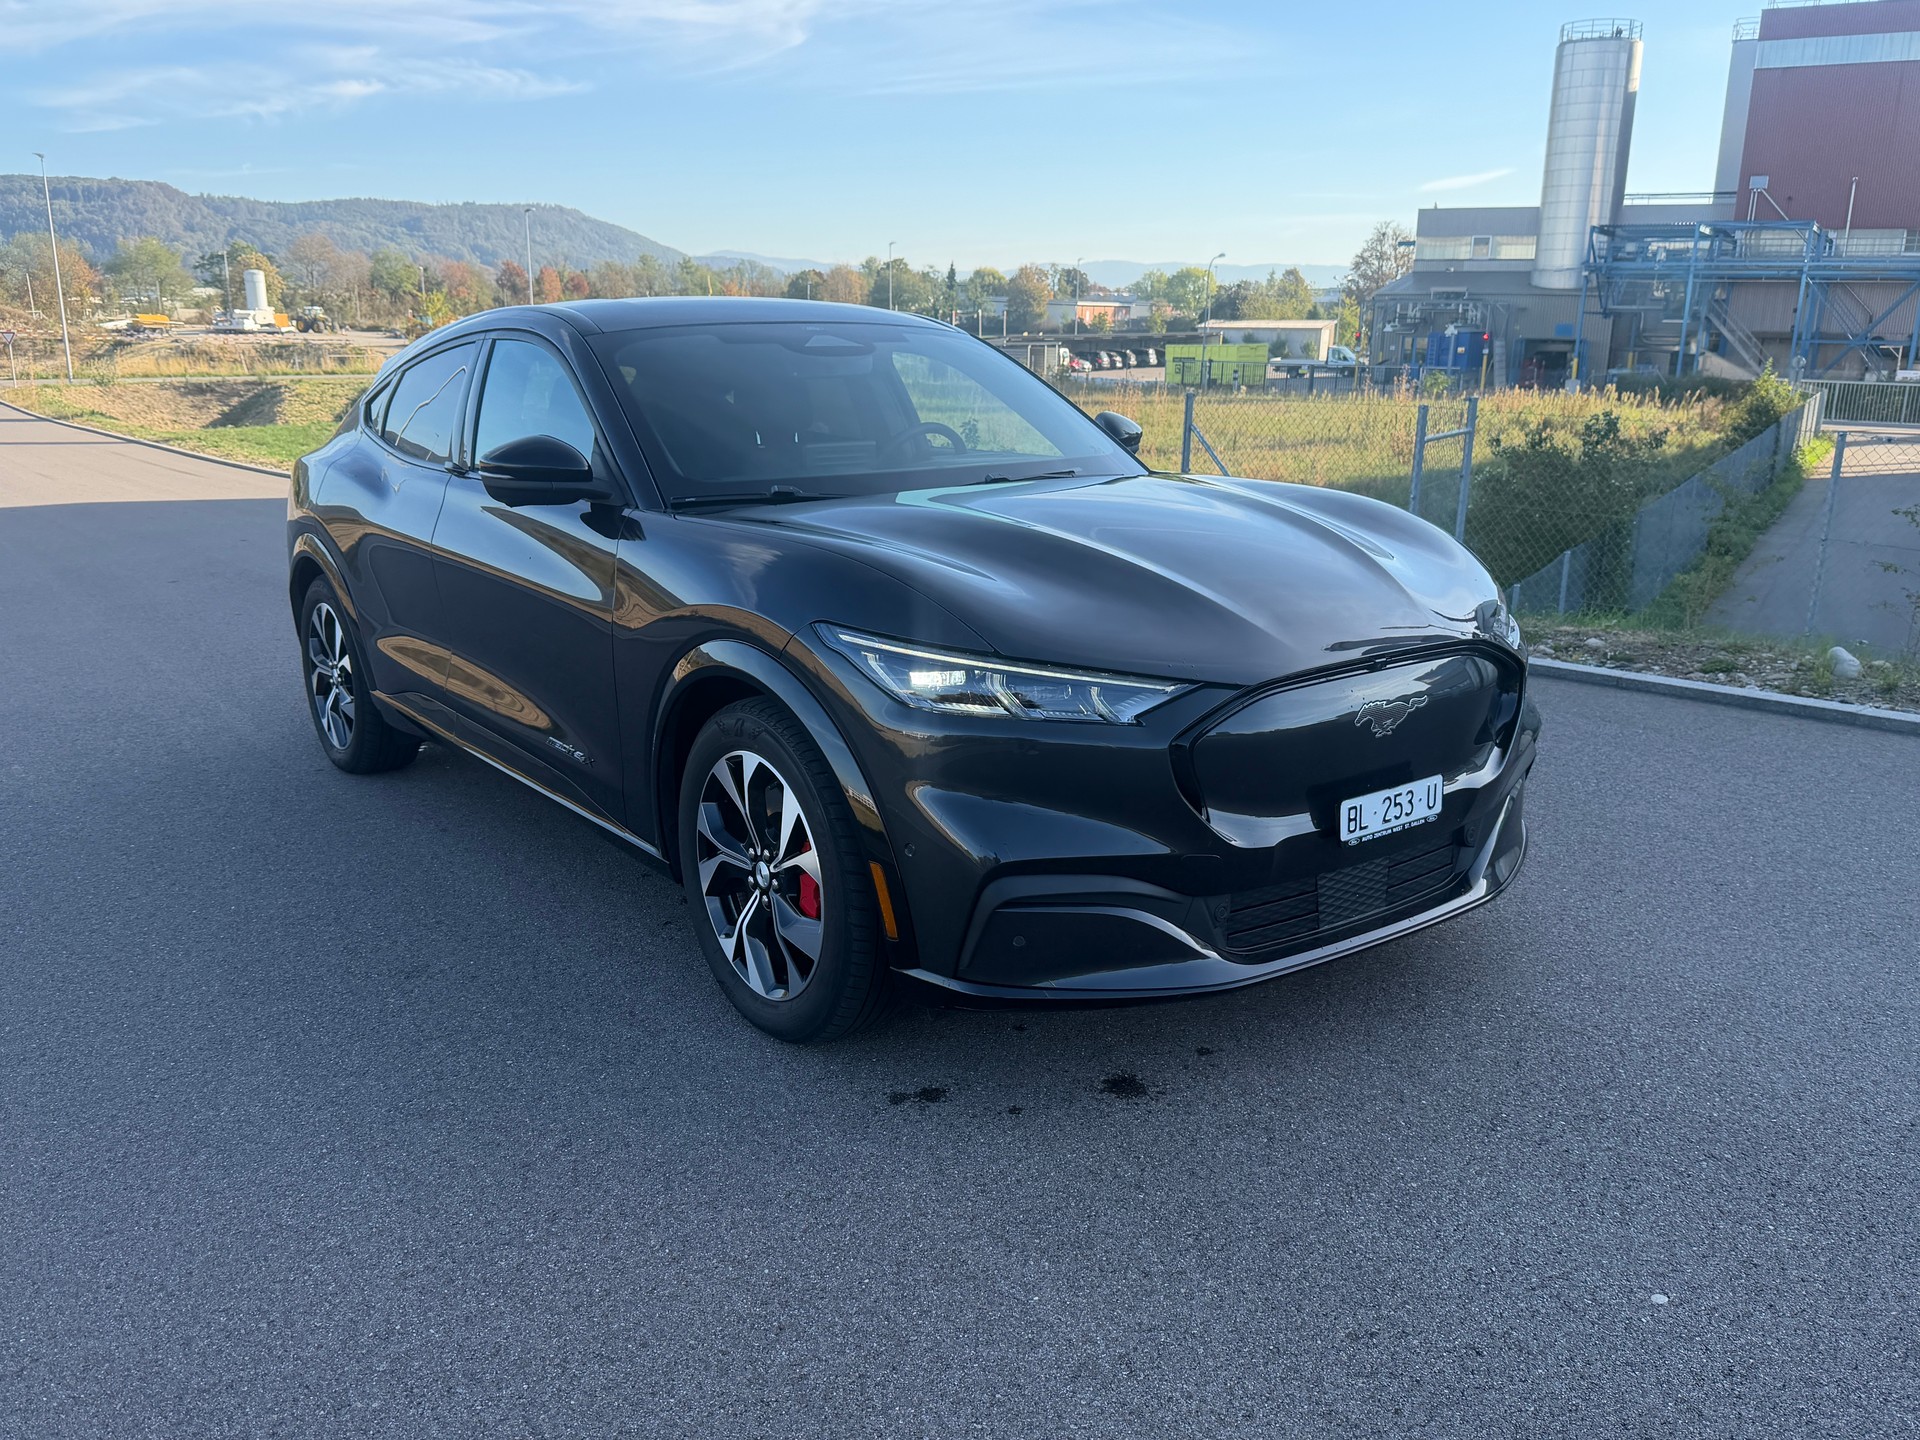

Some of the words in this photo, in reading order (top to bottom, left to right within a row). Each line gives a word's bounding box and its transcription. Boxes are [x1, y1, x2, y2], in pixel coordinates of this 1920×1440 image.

[1348, 804, 1368, 833] BL
[1382, 789, 1414, 824] 253
[1427, 783, 1437, 810] U
[1362, 834, 1373, 842] AUTO
[1393, 825, 1403, 833] WEST
[1411, 819, 1425, 827] GALLEN
